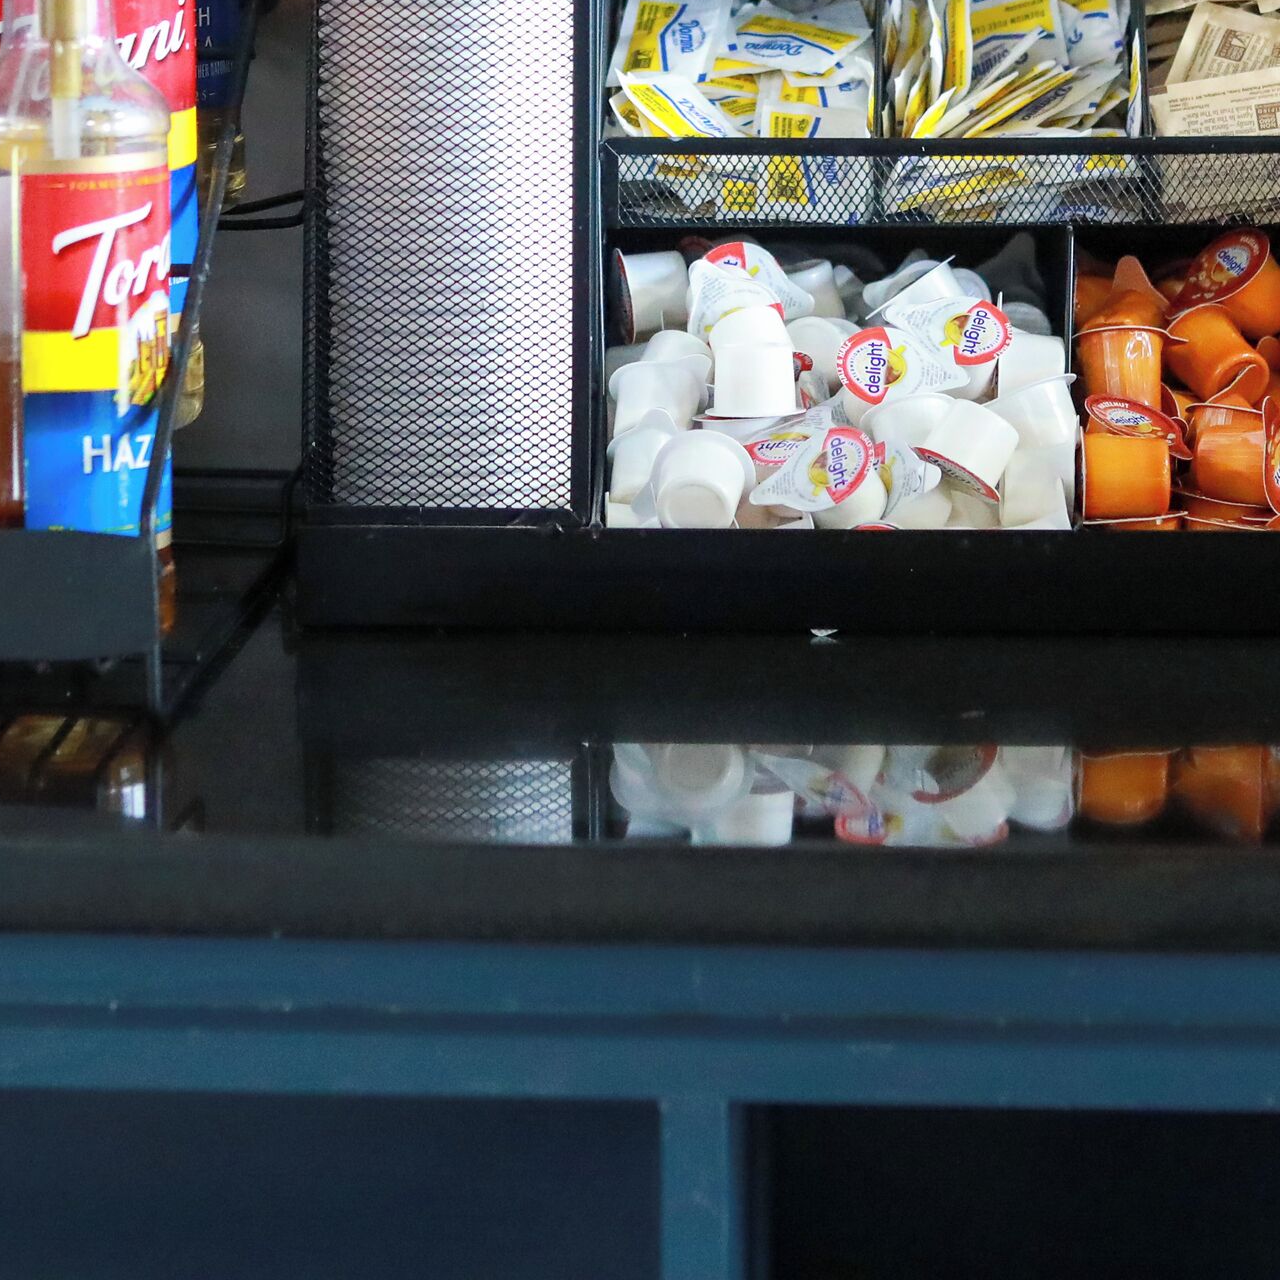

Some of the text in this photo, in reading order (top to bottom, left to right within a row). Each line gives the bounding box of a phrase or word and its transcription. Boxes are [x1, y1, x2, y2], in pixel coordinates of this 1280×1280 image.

[1217, 248, 1246, 277] delight
[837, 340, 852, 357] HALF
[961, 310, 991, 354] delight
[837, 365, 849, 385] HALF
[864, 342, 887, 394] delight
[828, 437, 849, 489] delight
